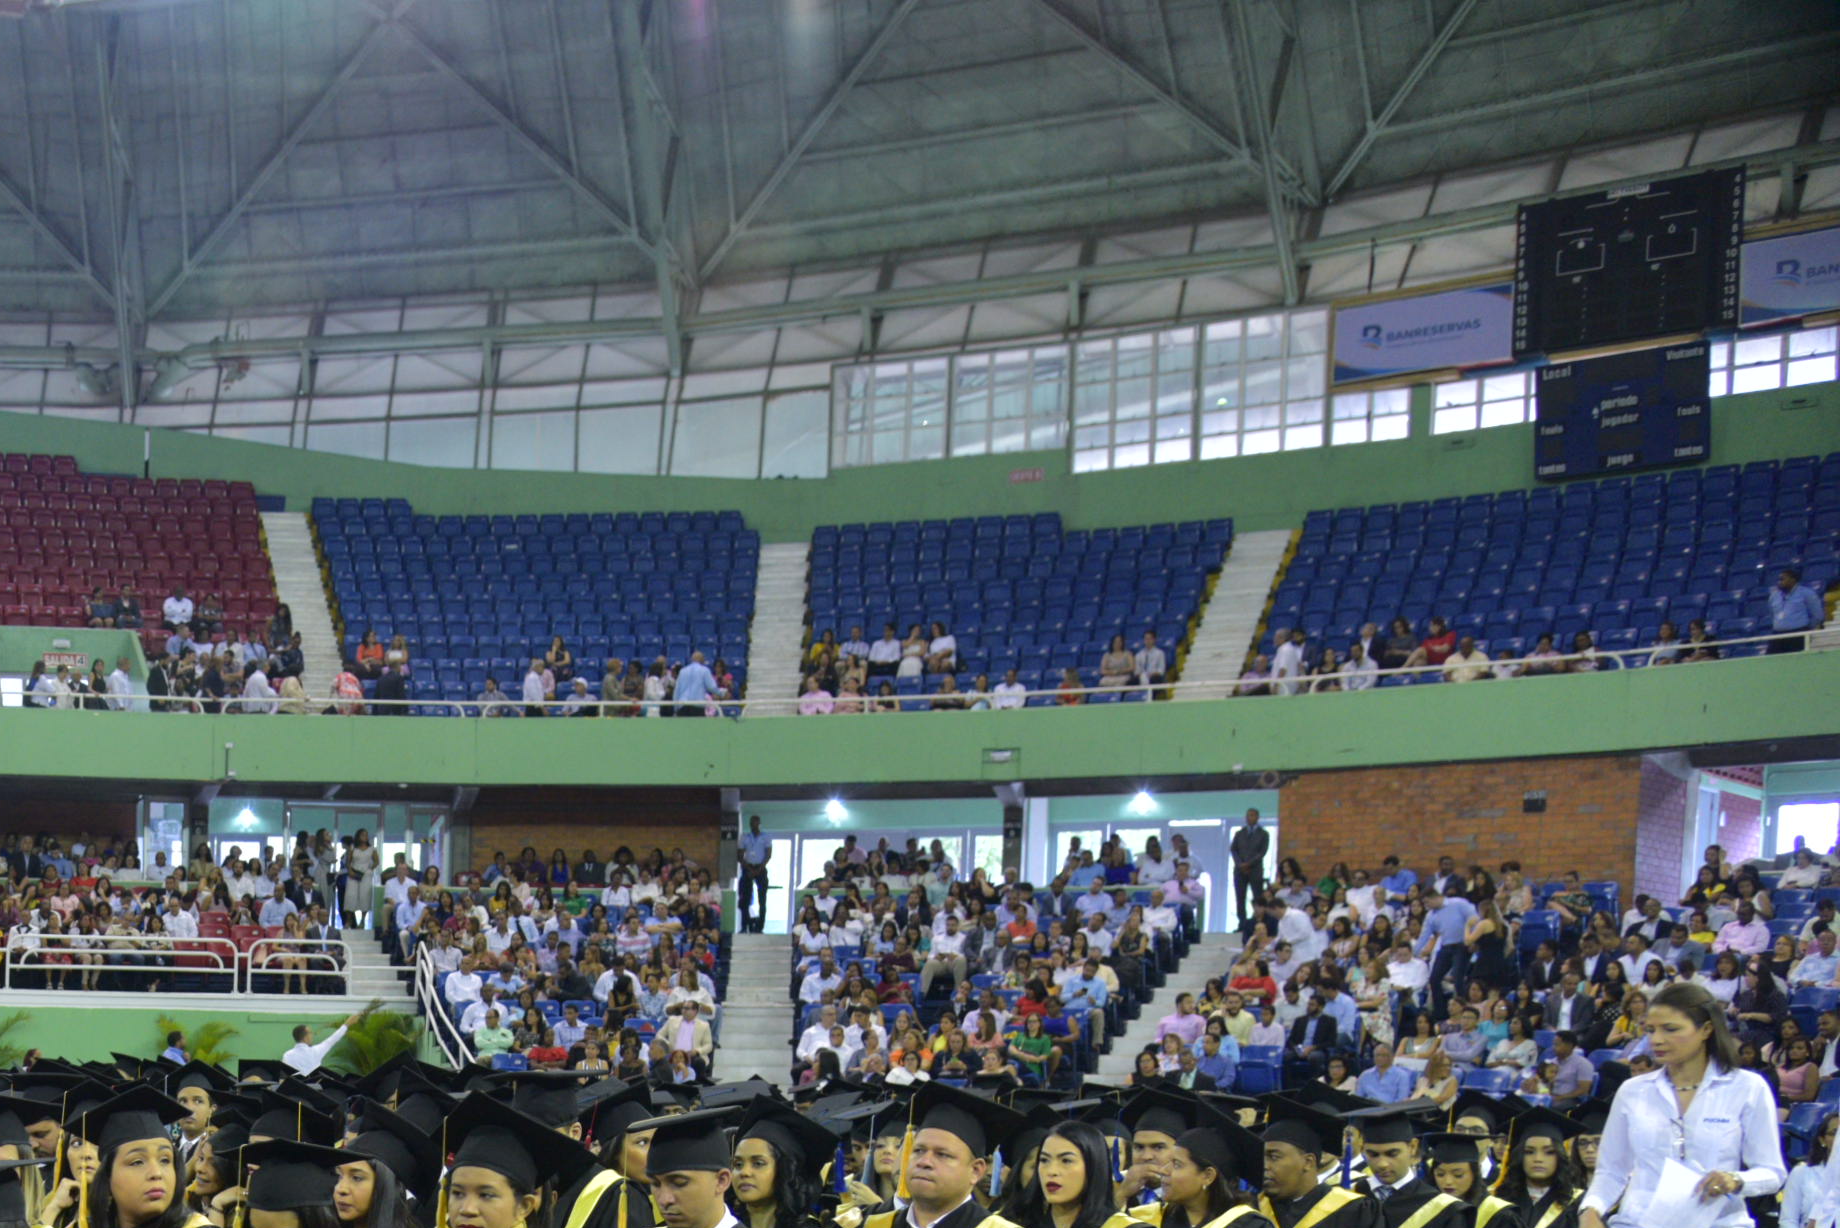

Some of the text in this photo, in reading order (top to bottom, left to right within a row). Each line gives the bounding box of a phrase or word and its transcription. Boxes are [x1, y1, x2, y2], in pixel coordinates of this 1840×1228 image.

[1386, 318, 1481, 342] BANRESERVAS
[1543, 365, 1571, 380] Local
[1607, 452, 1634, 467] juego
